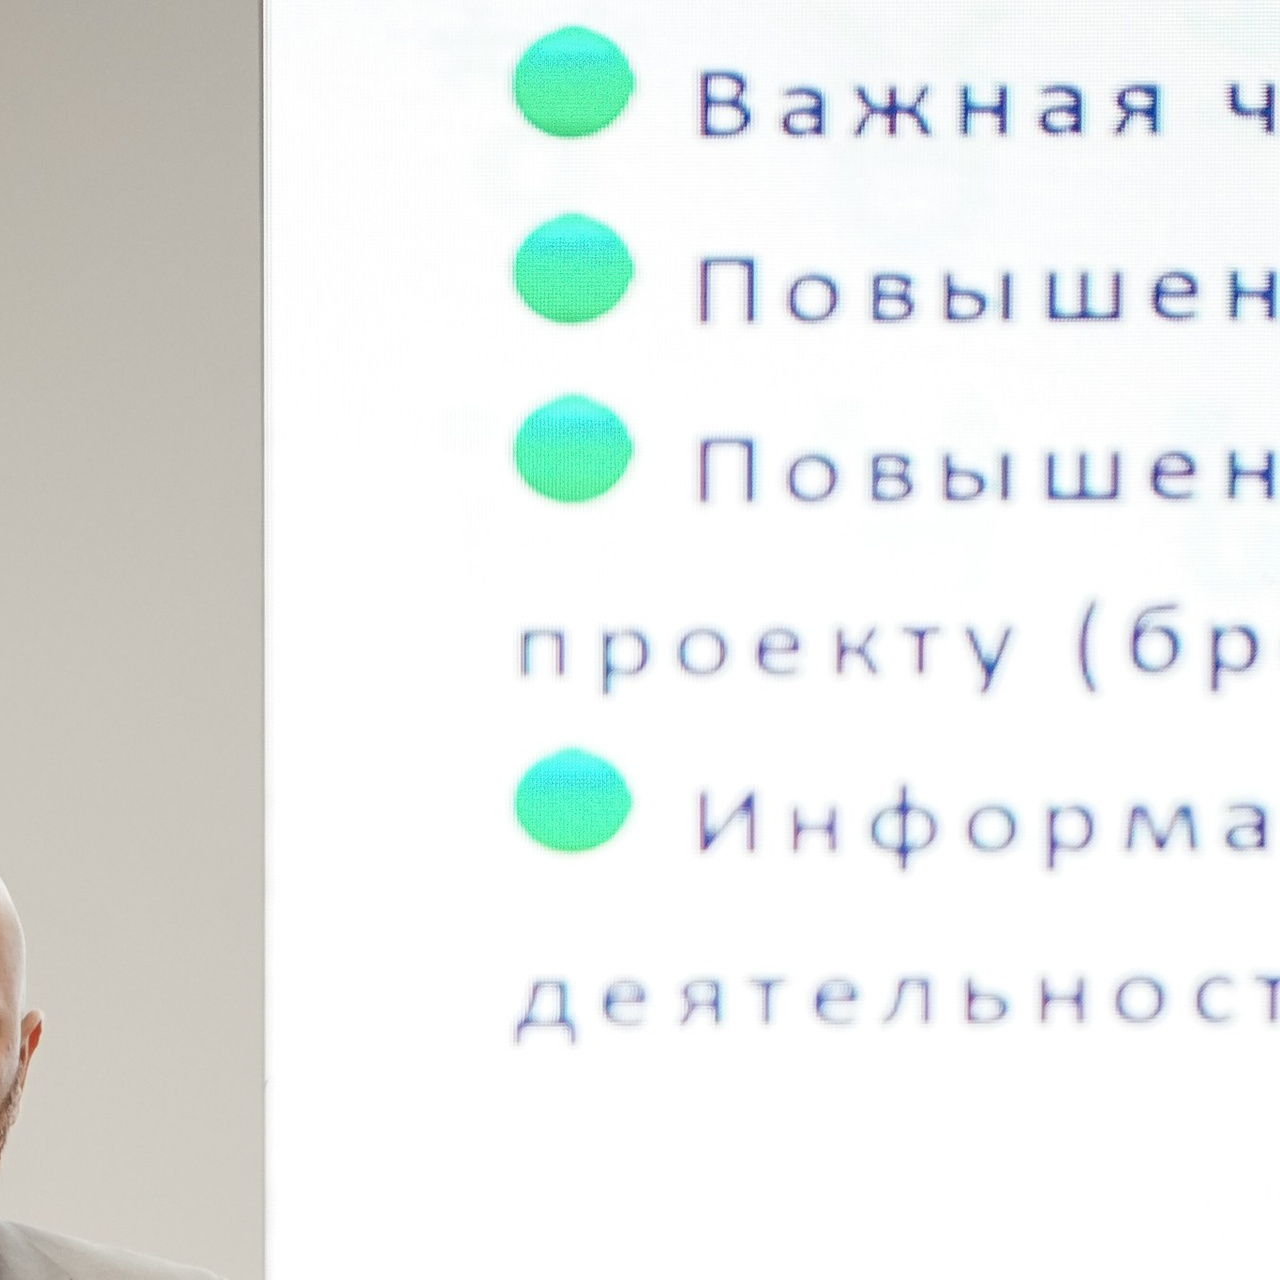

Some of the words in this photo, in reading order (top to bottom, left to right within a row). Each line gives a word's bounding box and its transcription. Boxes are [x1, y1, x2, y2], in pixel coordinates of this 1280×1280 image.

[699, 70, 1163, 138] Важная
[1227, 82, 1277, 136] ч
[699, 256, 1279, 324] Повышен
[699, 437, 1279, 503] Повышен
[519, 624, 1013, 695] проекту
[699, 785, 1269, 871] Информа
[514, 973, 1280, 1045] деятельност
